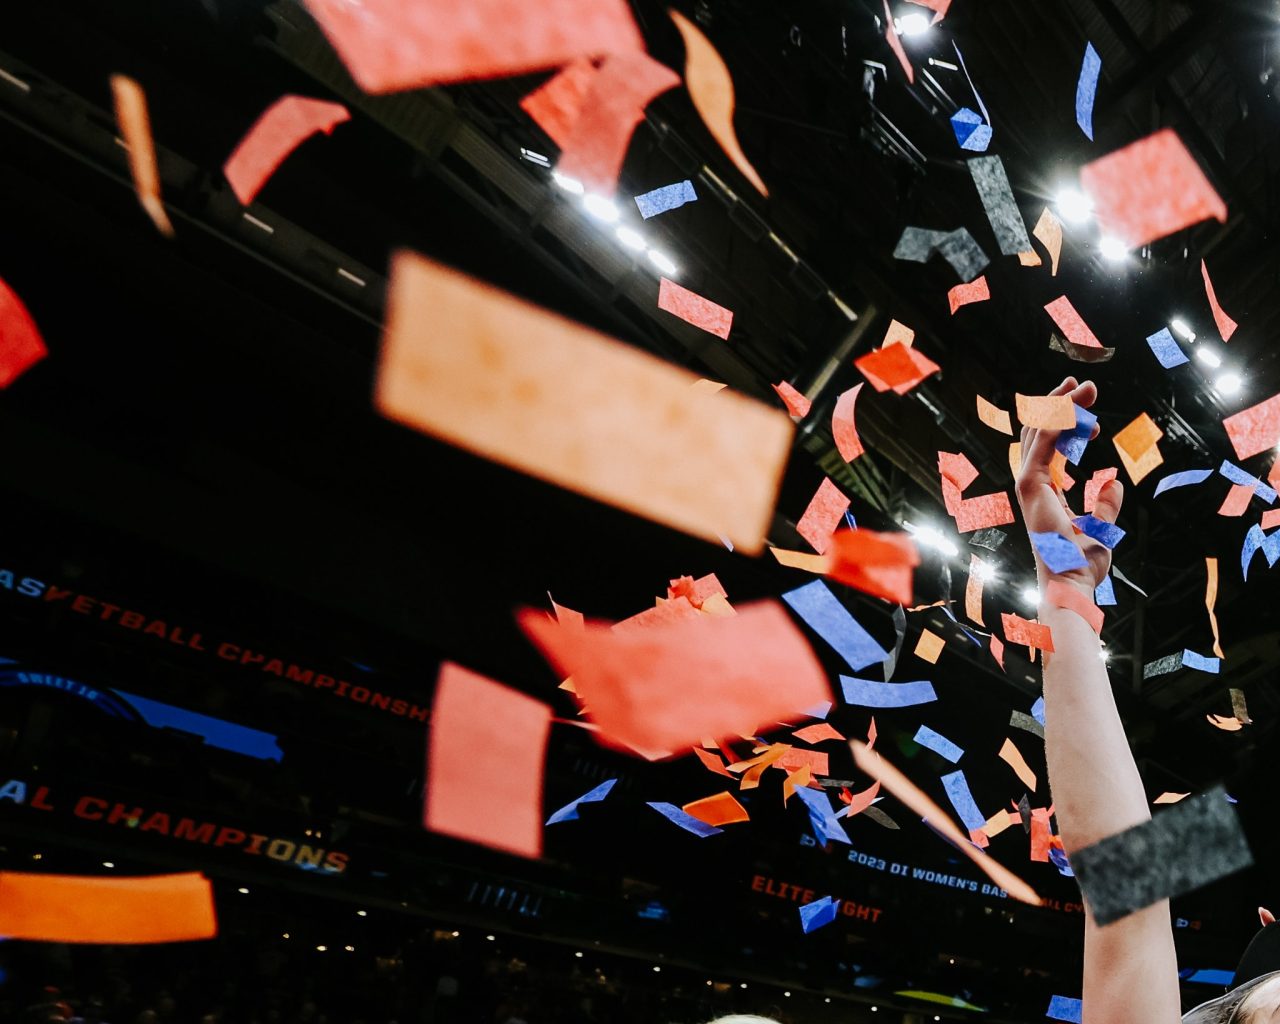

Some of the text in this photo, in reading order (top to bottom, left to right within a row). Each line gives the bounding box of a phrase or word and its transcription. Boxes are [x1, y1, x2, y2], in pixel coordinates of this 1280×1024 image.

[217, 642, 431, 726] CHAMPIONSH
[73, 796, 351, 874] CHAMPIONS
[751, 872, 883, 924] ELITE GHT
[847, 849, 887, 871] 2023
[911, 867, 979, 892] WOMEN'S
